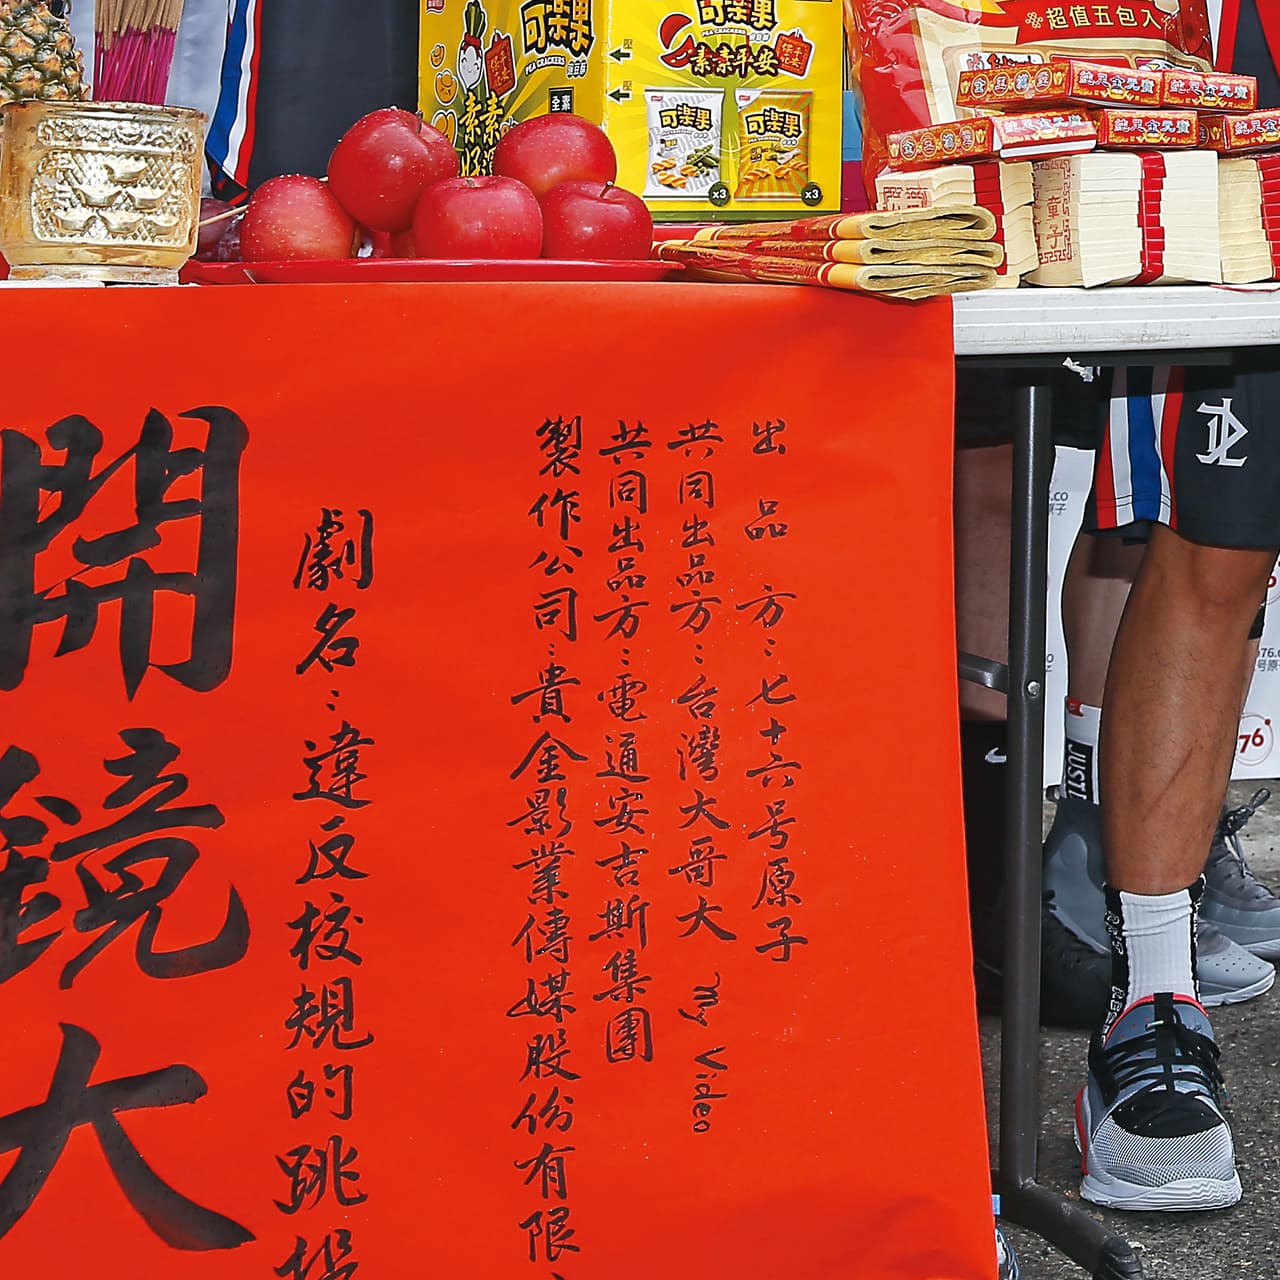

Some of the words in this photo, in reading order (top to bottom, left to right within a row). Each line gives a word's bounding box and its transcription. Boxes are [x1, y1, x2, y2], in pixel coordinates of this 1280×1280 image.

[1045, 5, 1162, 32] 超值五包入
[552, 96, 571, 111] 全素
[1238, 728, 1265, 753] 76
[0, 405, 257, 1252] 開鏡大
[692, 1047, 729, 1133] Video
